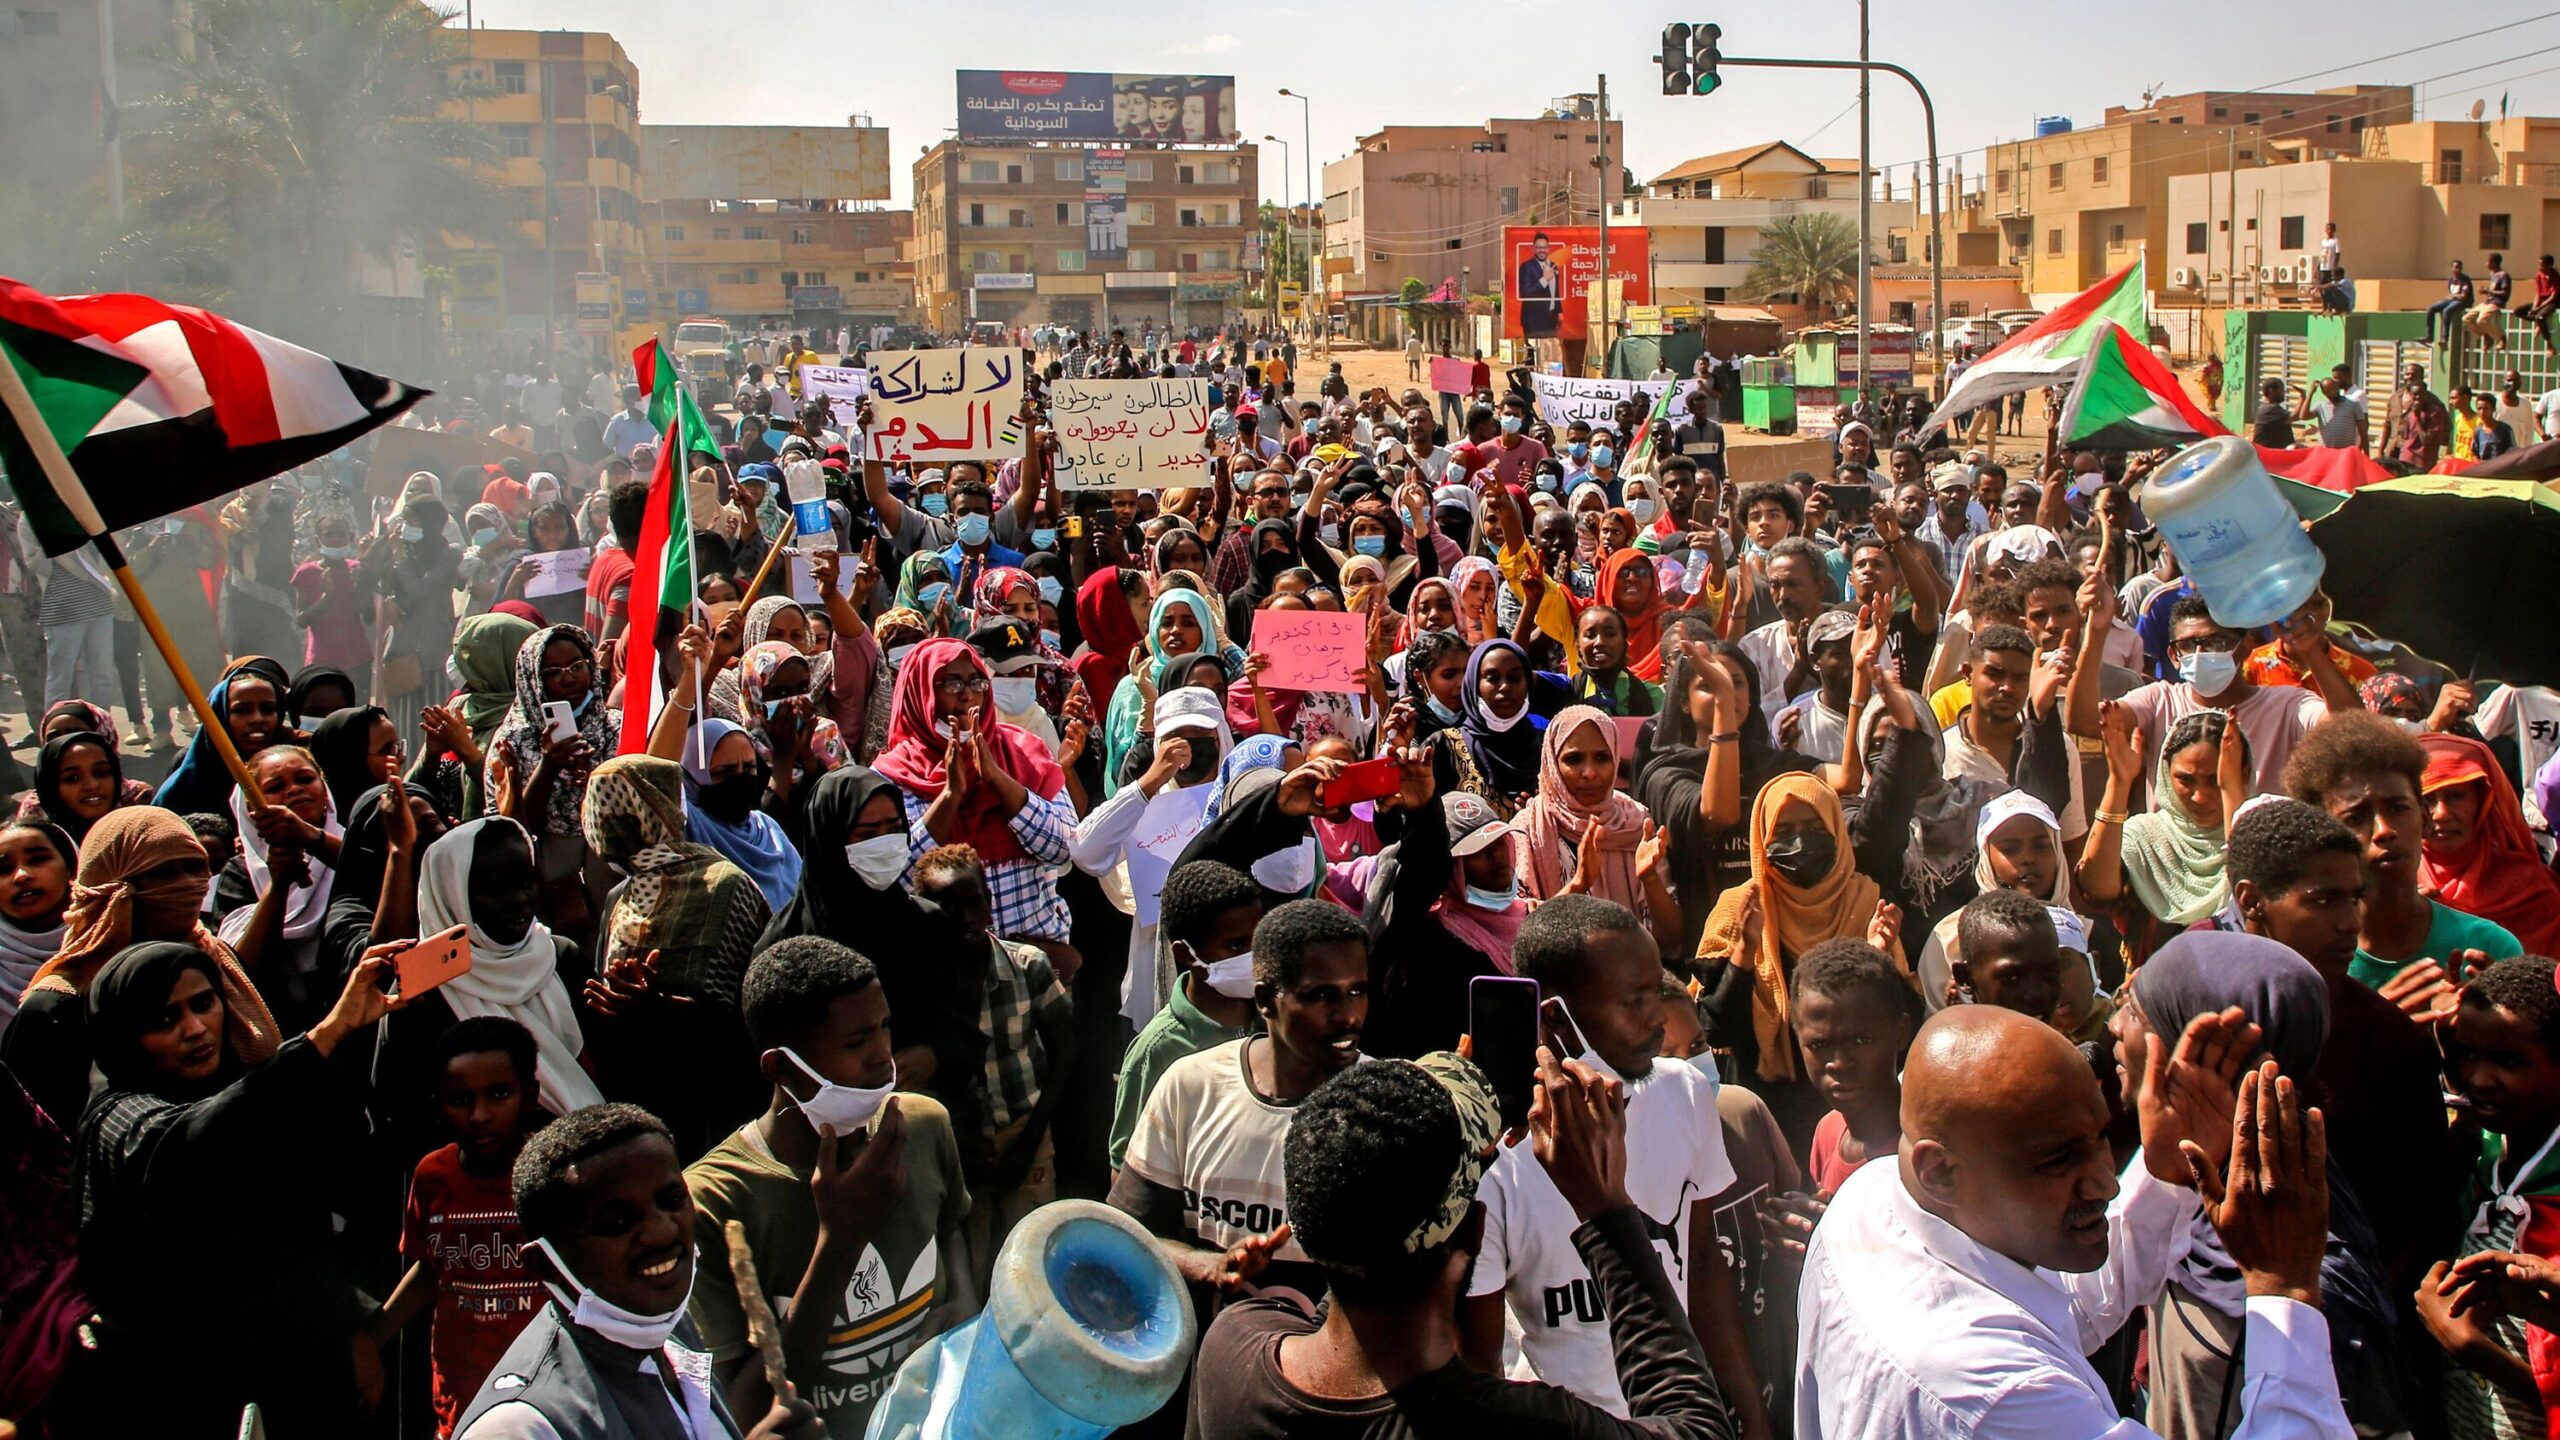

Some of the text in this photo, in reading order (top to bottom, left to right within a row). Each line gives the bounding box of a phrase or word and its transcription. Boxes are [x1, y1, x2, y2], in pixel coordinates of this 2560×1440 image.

[966, 97, 1020, 112] الضيافة
[1024, 98, 1060, 113] بكرم
[1004, 116, 1068, 131] السودانية
[1571, 258, 1600, 271] زحمة
[868, 350, 1012, 404] لا لشراكة
[1054, 379, 1201, 414] الظالمون سيرحلون
[873, 400, 993, 462] الدم
[1081, 416, 1138, 441] يعودوا
[1149, 410, 1175, 437] لن
[1182, 405, 1208, 434] لا
[1054, 442, 1207, 472] جديد إن عادوا
[1075, 467, 1117, 486] عدنا
[1006, 625, 1023, 647] A
[458, 1295, 531, 1313] FASHION
